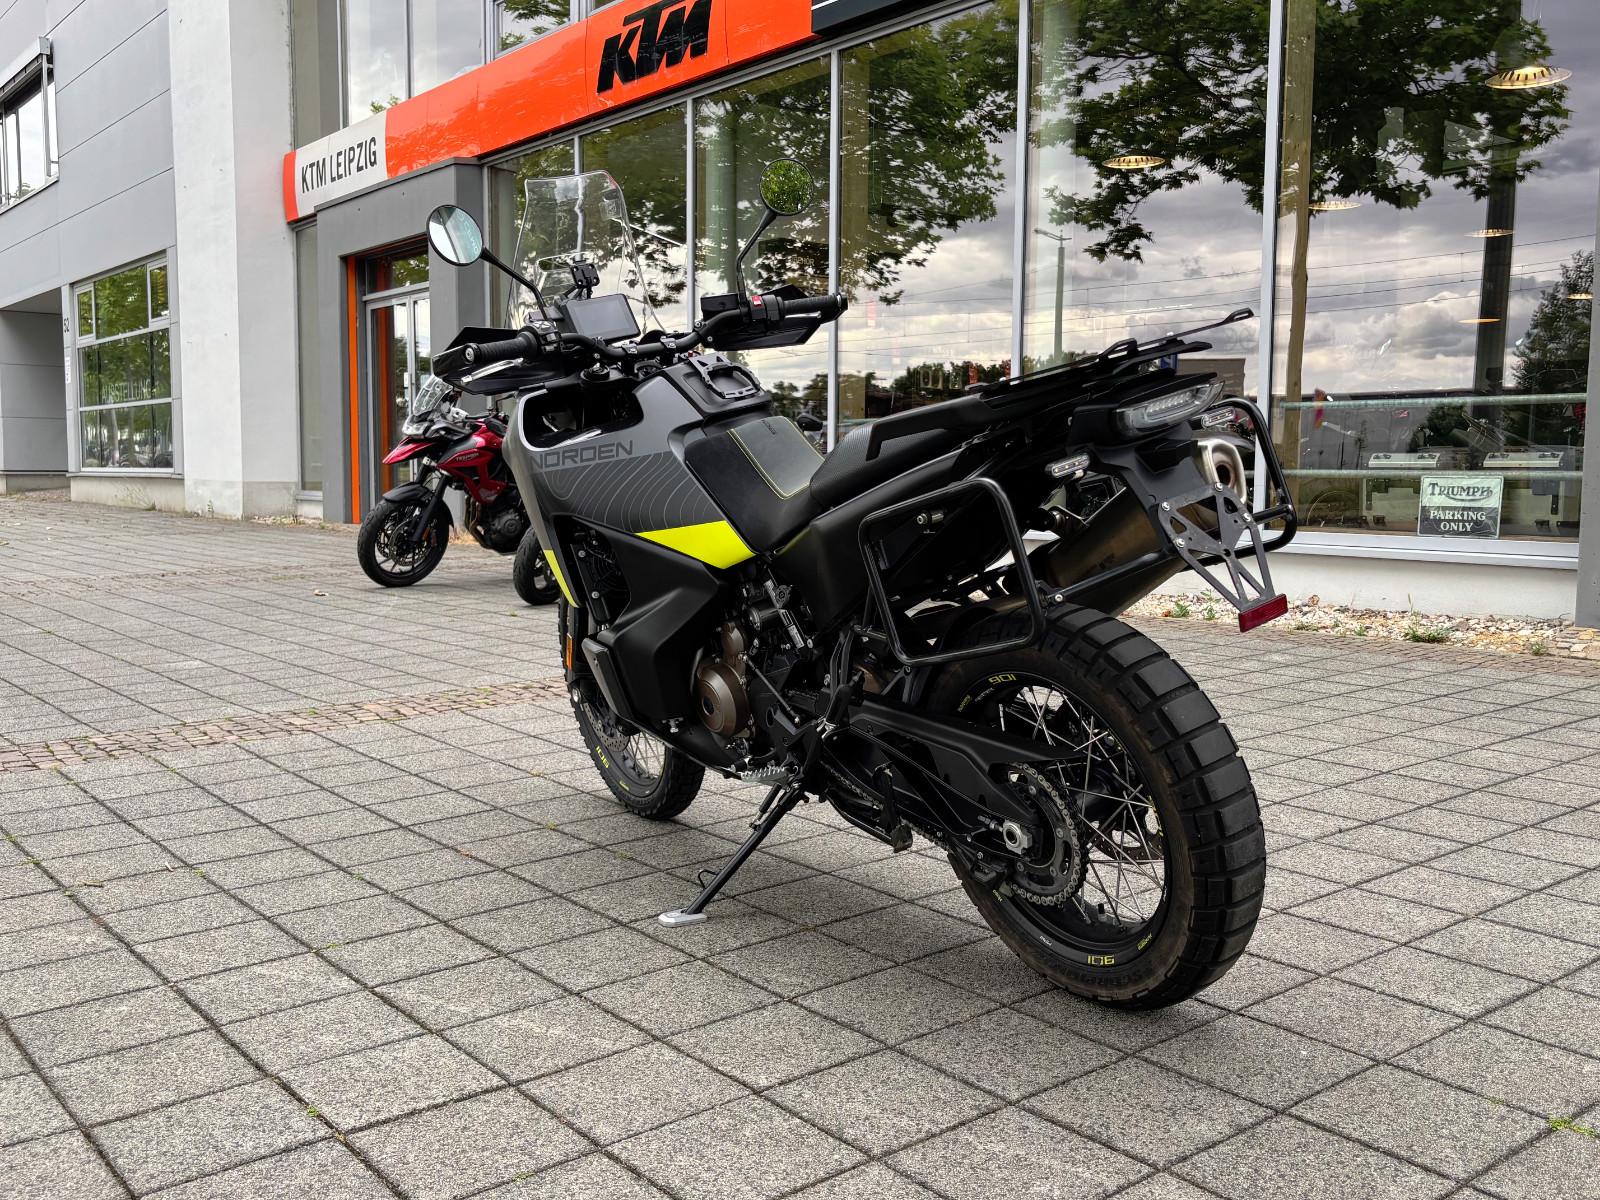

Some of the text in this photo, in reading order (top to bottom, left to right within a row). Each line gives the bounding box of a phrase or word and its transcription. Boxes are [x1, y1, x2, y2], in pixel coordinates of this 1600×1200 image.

[596, 0, 712, 94] KTM
[301, 136, 377, 194] KTM LEIPZIG
[530, 439, 634, 472] NORDEN
[1428, 482, 1493, 502] TRIUMPH
[1430, 510, 1487, 521] PARKING
[1440, 521, 1473, 532] ONLY
[988, 673, 1017, 685] 901
[1087, 954, 1115, 966] 901
